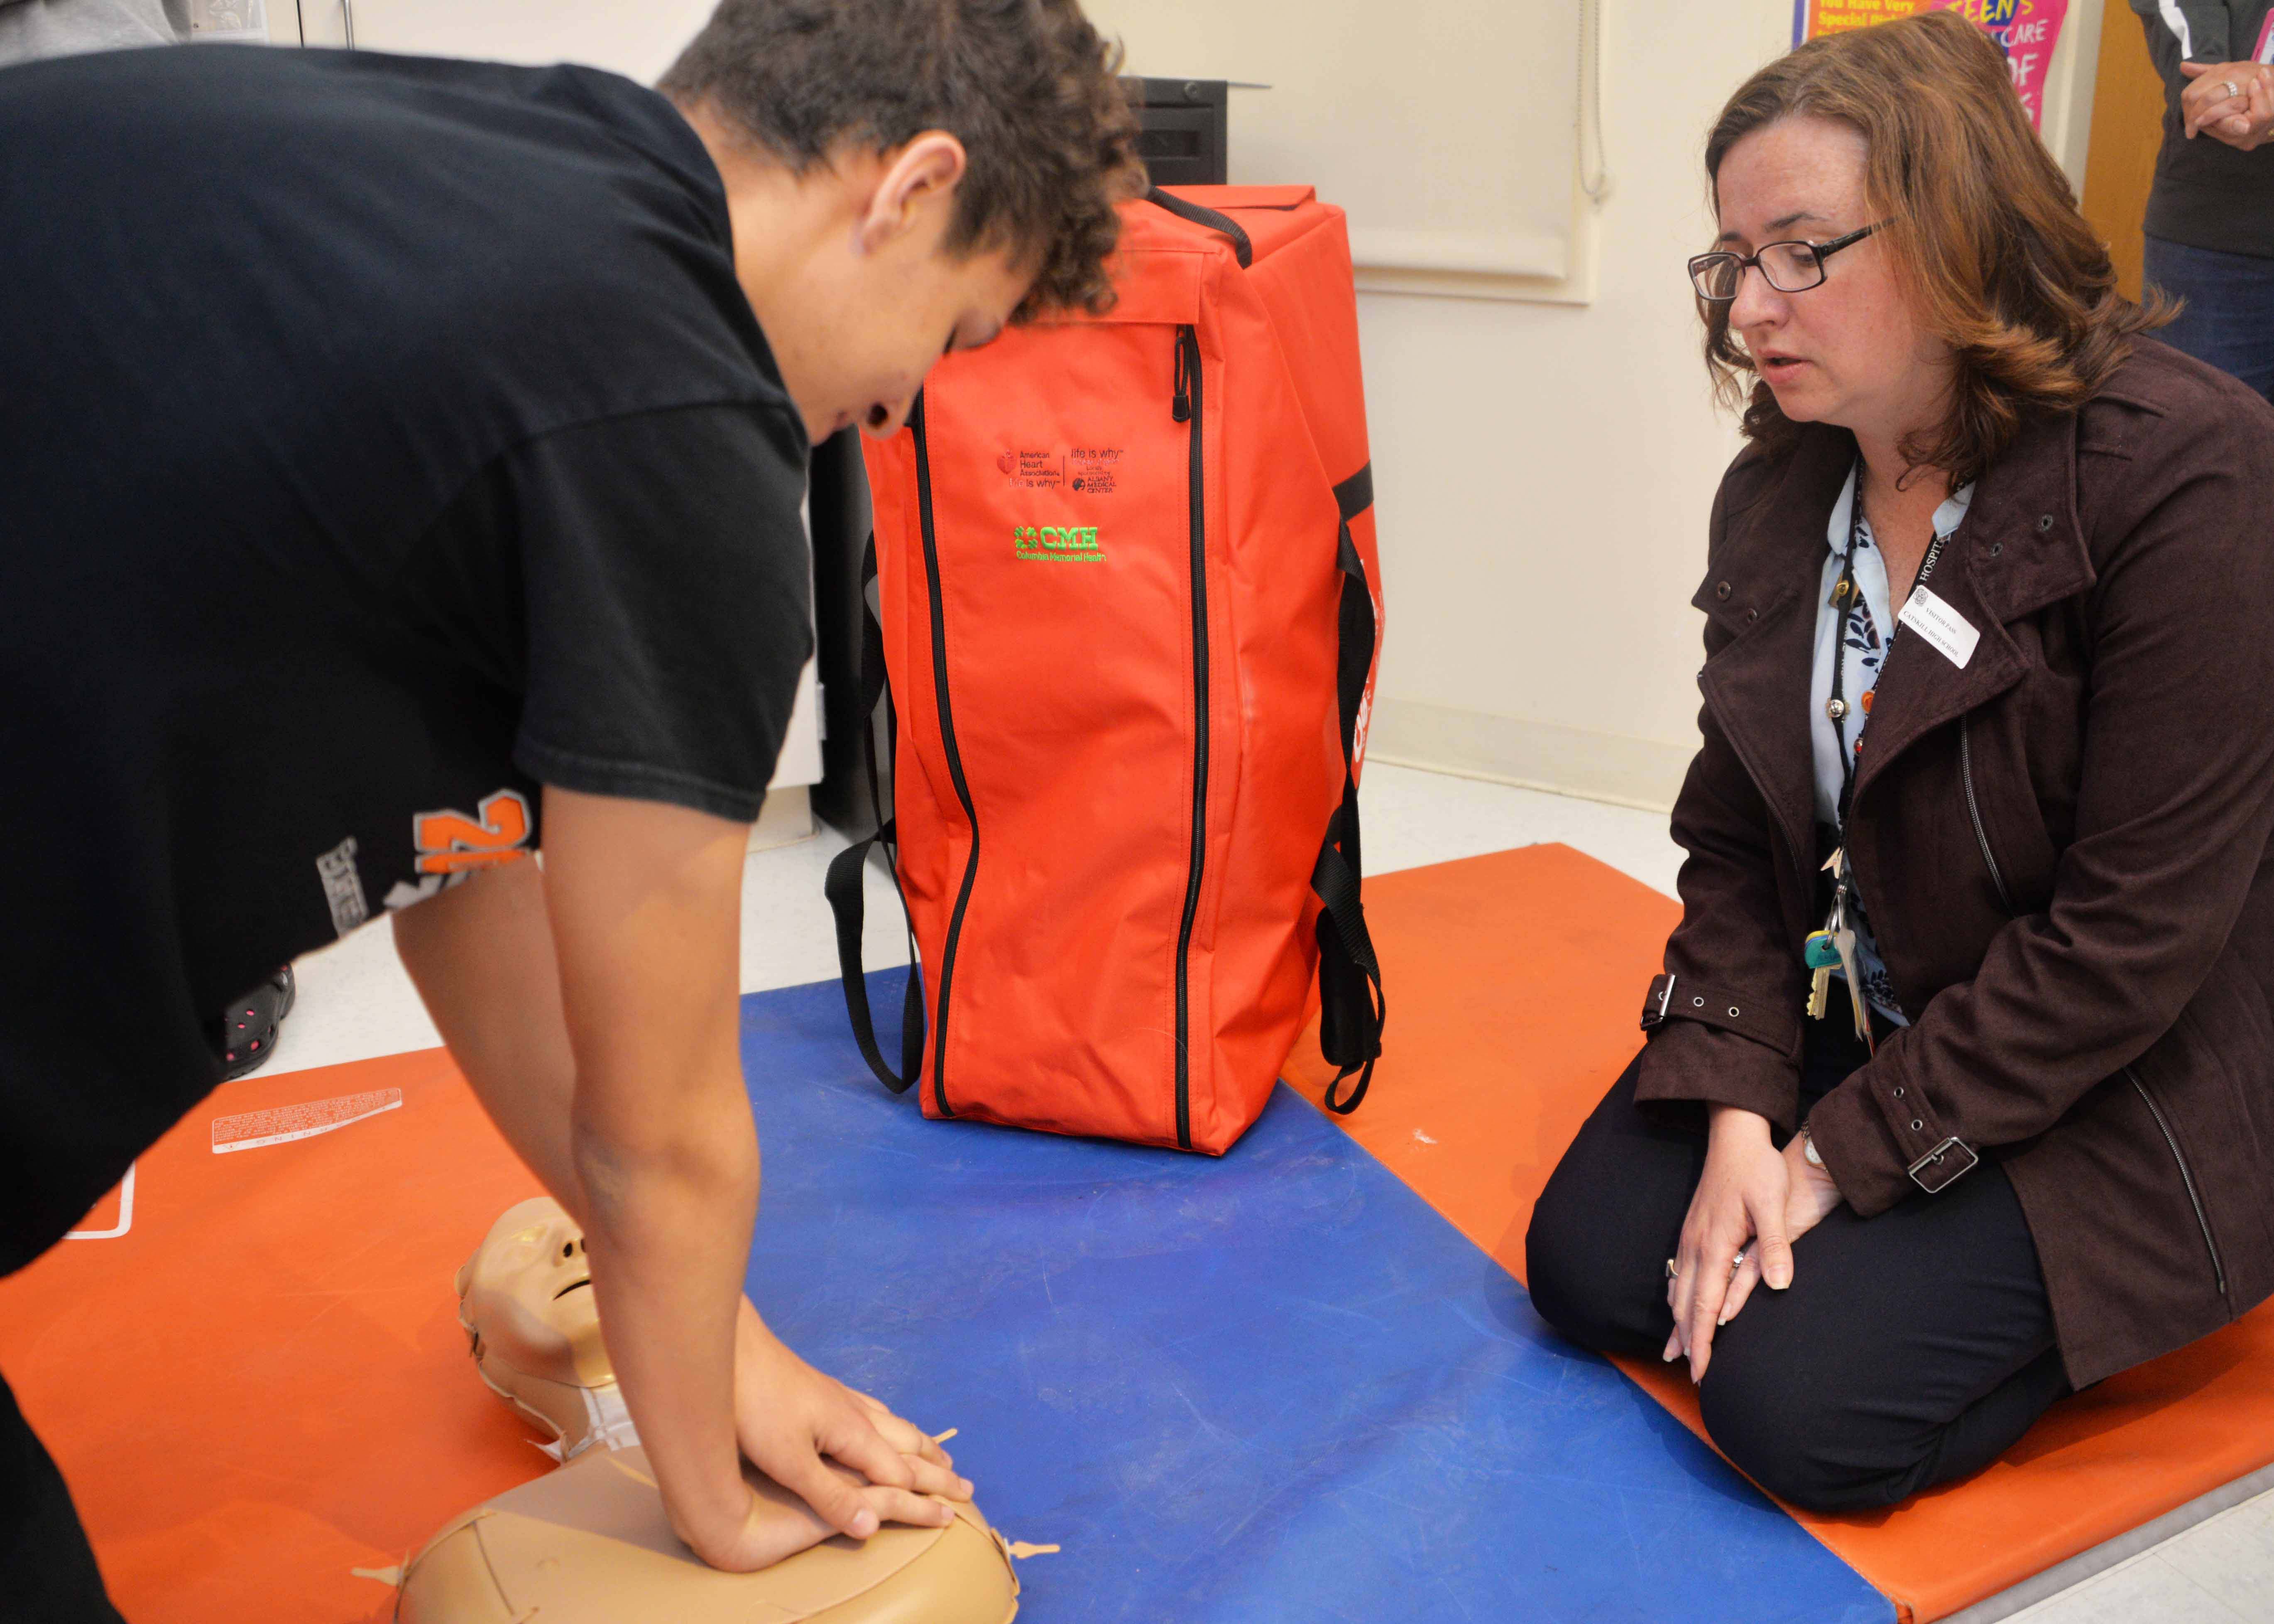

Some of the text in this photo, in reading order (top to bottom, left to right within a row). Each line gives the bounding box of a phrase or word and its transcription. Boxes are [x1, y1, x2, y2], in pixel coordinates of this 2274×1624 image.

[1848, 0, 1881, 10] Have
[1885, 0, 1914, 12] Very
[1819, 11, 1868, 28] Special
[2000, 19, 2049, 48] CARE
[1071, 449, 1085, 458] life
[1089, 449, 1096, 458] is
[1020, 460, 1043, 468] Heart
[1026, 479, 1033, 487] is
[1040, 526, 1099, 550] CMH
[1016, 551, 1049, 560] Columbia
[1050, 552, 1082, 562] Memorial
[1919, 541, 1942, 582] HOSPIT
[1926, 607, 1957, 634] VISITOR PASS
[1903, 610, 1960, 658] CATSKILL HIGH SCHOOL
